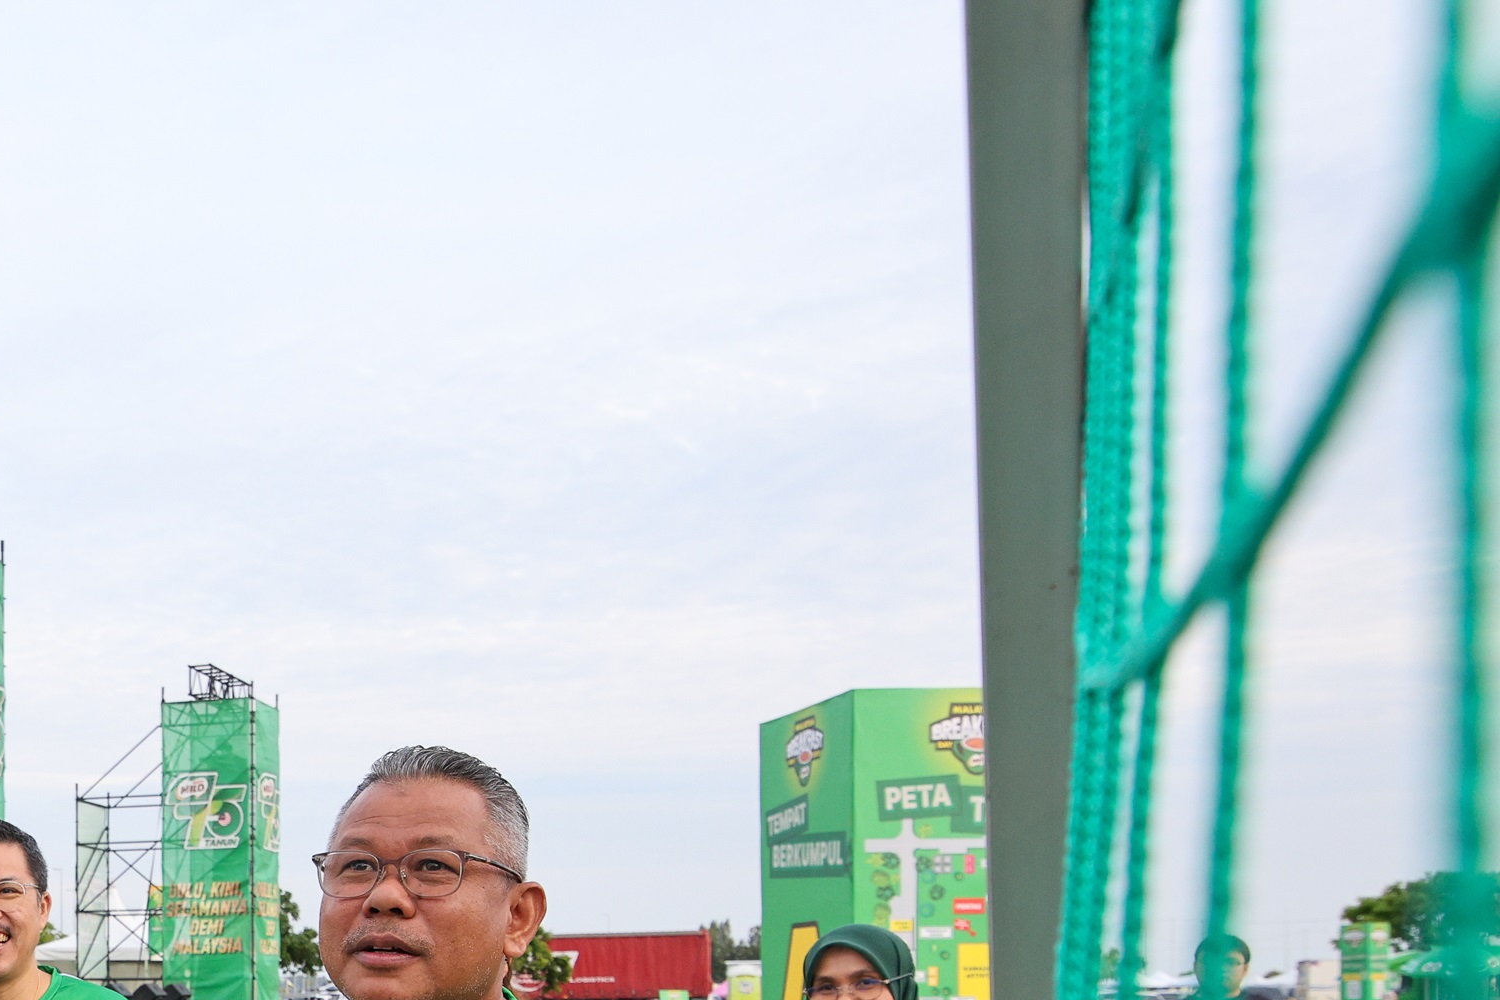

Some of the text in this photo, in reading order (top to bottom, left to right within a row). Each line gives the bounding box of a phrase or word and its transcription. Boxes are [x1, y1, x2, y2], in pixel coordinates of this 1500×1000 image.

[952, 705, 984, 715] MALA
[930, 714, 985, 742] BREAK
[884, 783, 953, 811] PETA
[766, 801, 807, 837] TEMPAT
[771, 840, 844, 869] BERKUMPUL
[210, 881, 243, 898] KINI,
[166, 899, 248, 918] SELAMANYA
[190, 918, 225, 937] DEMI
[173, 937, 243, 955] MALAYSIA
